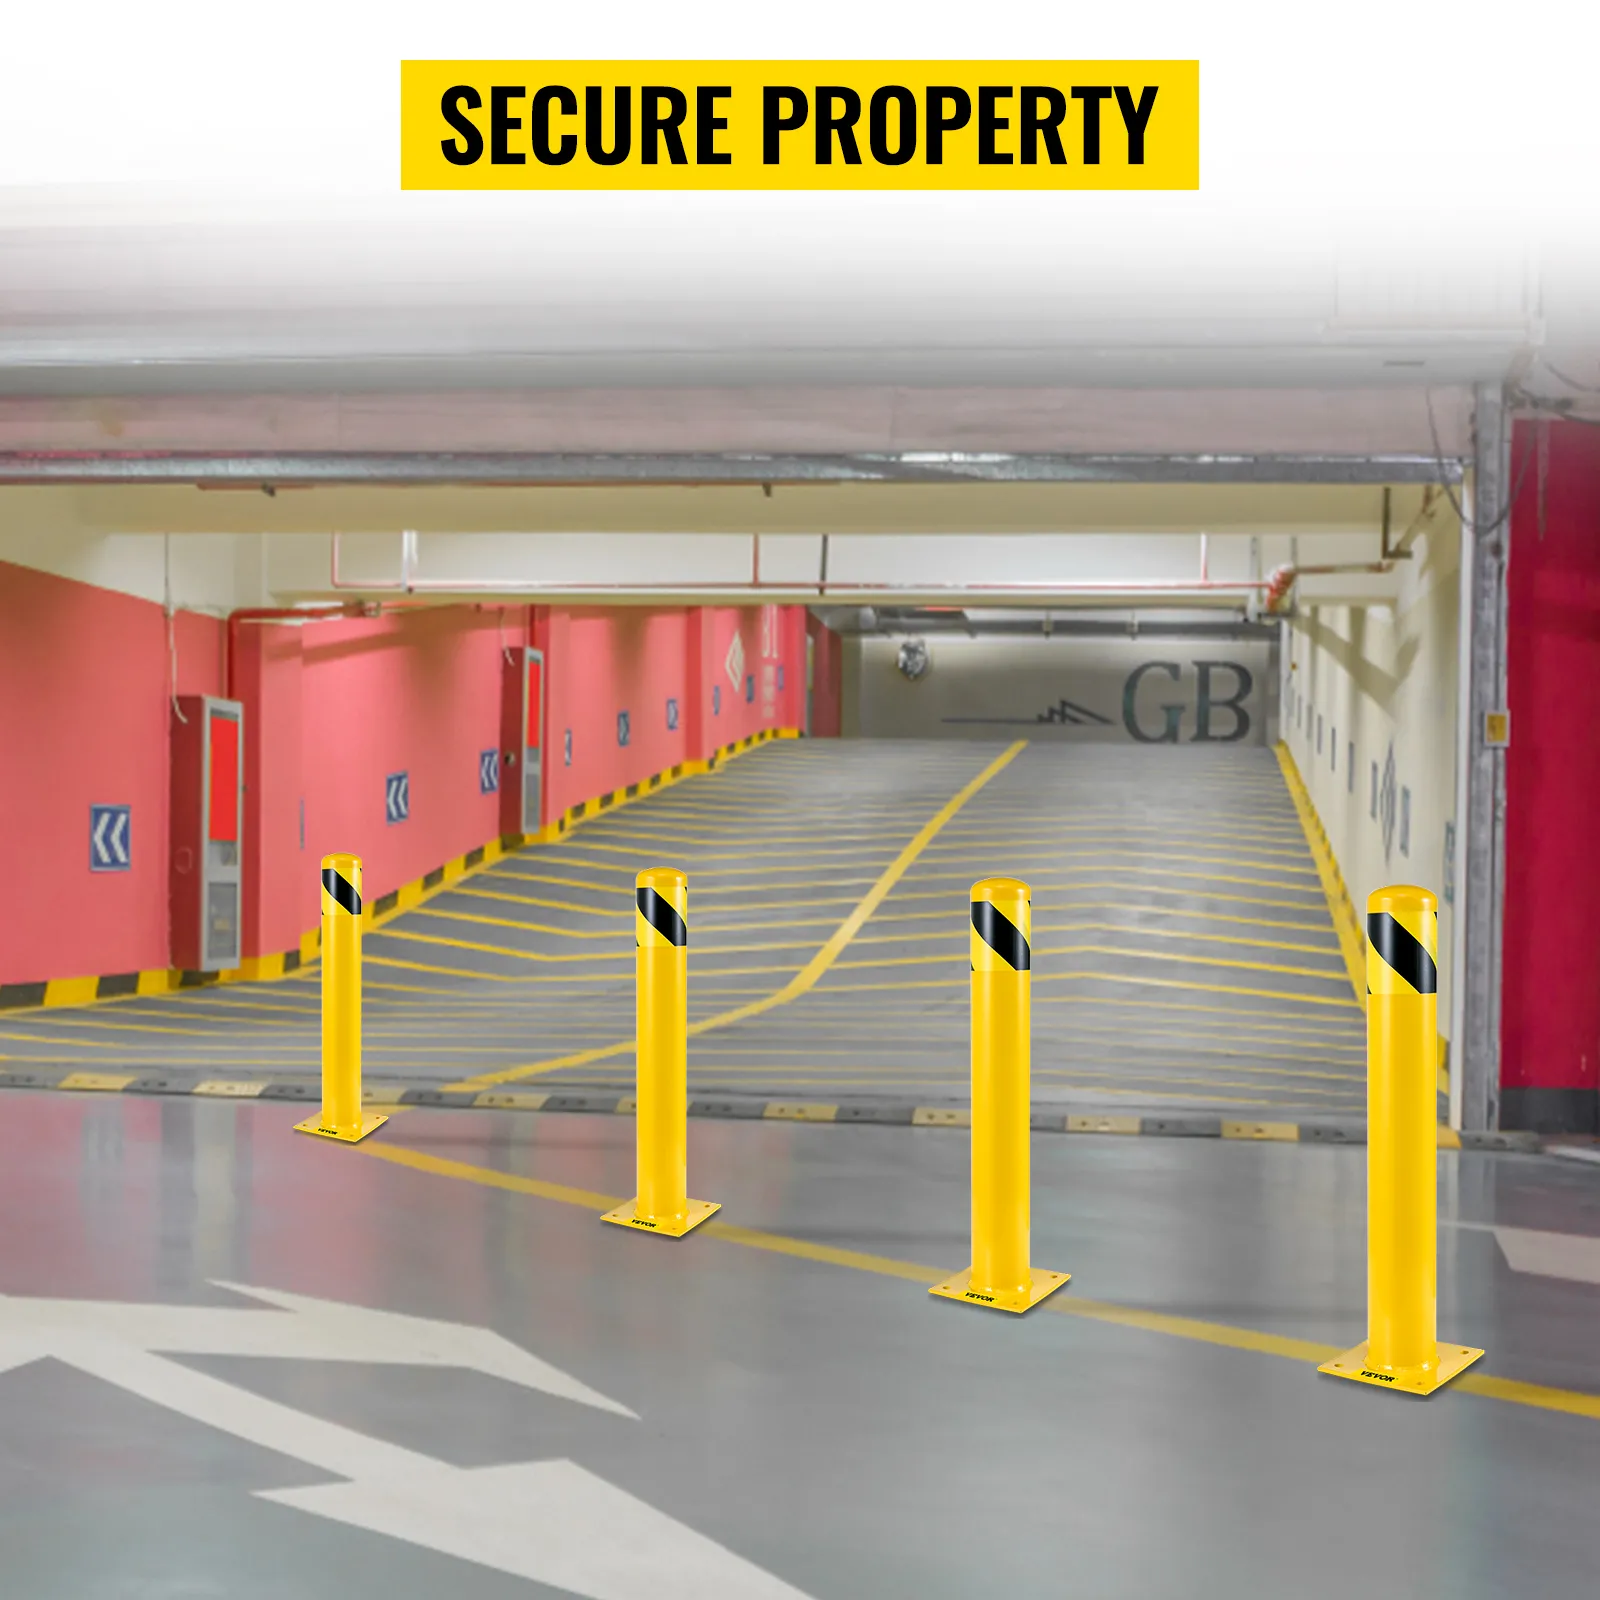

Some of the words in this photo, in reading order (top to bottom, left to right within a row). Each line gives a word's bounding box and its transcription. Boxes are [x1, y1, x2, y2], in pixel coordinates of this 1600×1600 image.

[1122, 661, 1253, 743] GB
[965, 1292, 995, 1302] VEVOR
[1360, 1370, 1395, 1382] VEVOR
